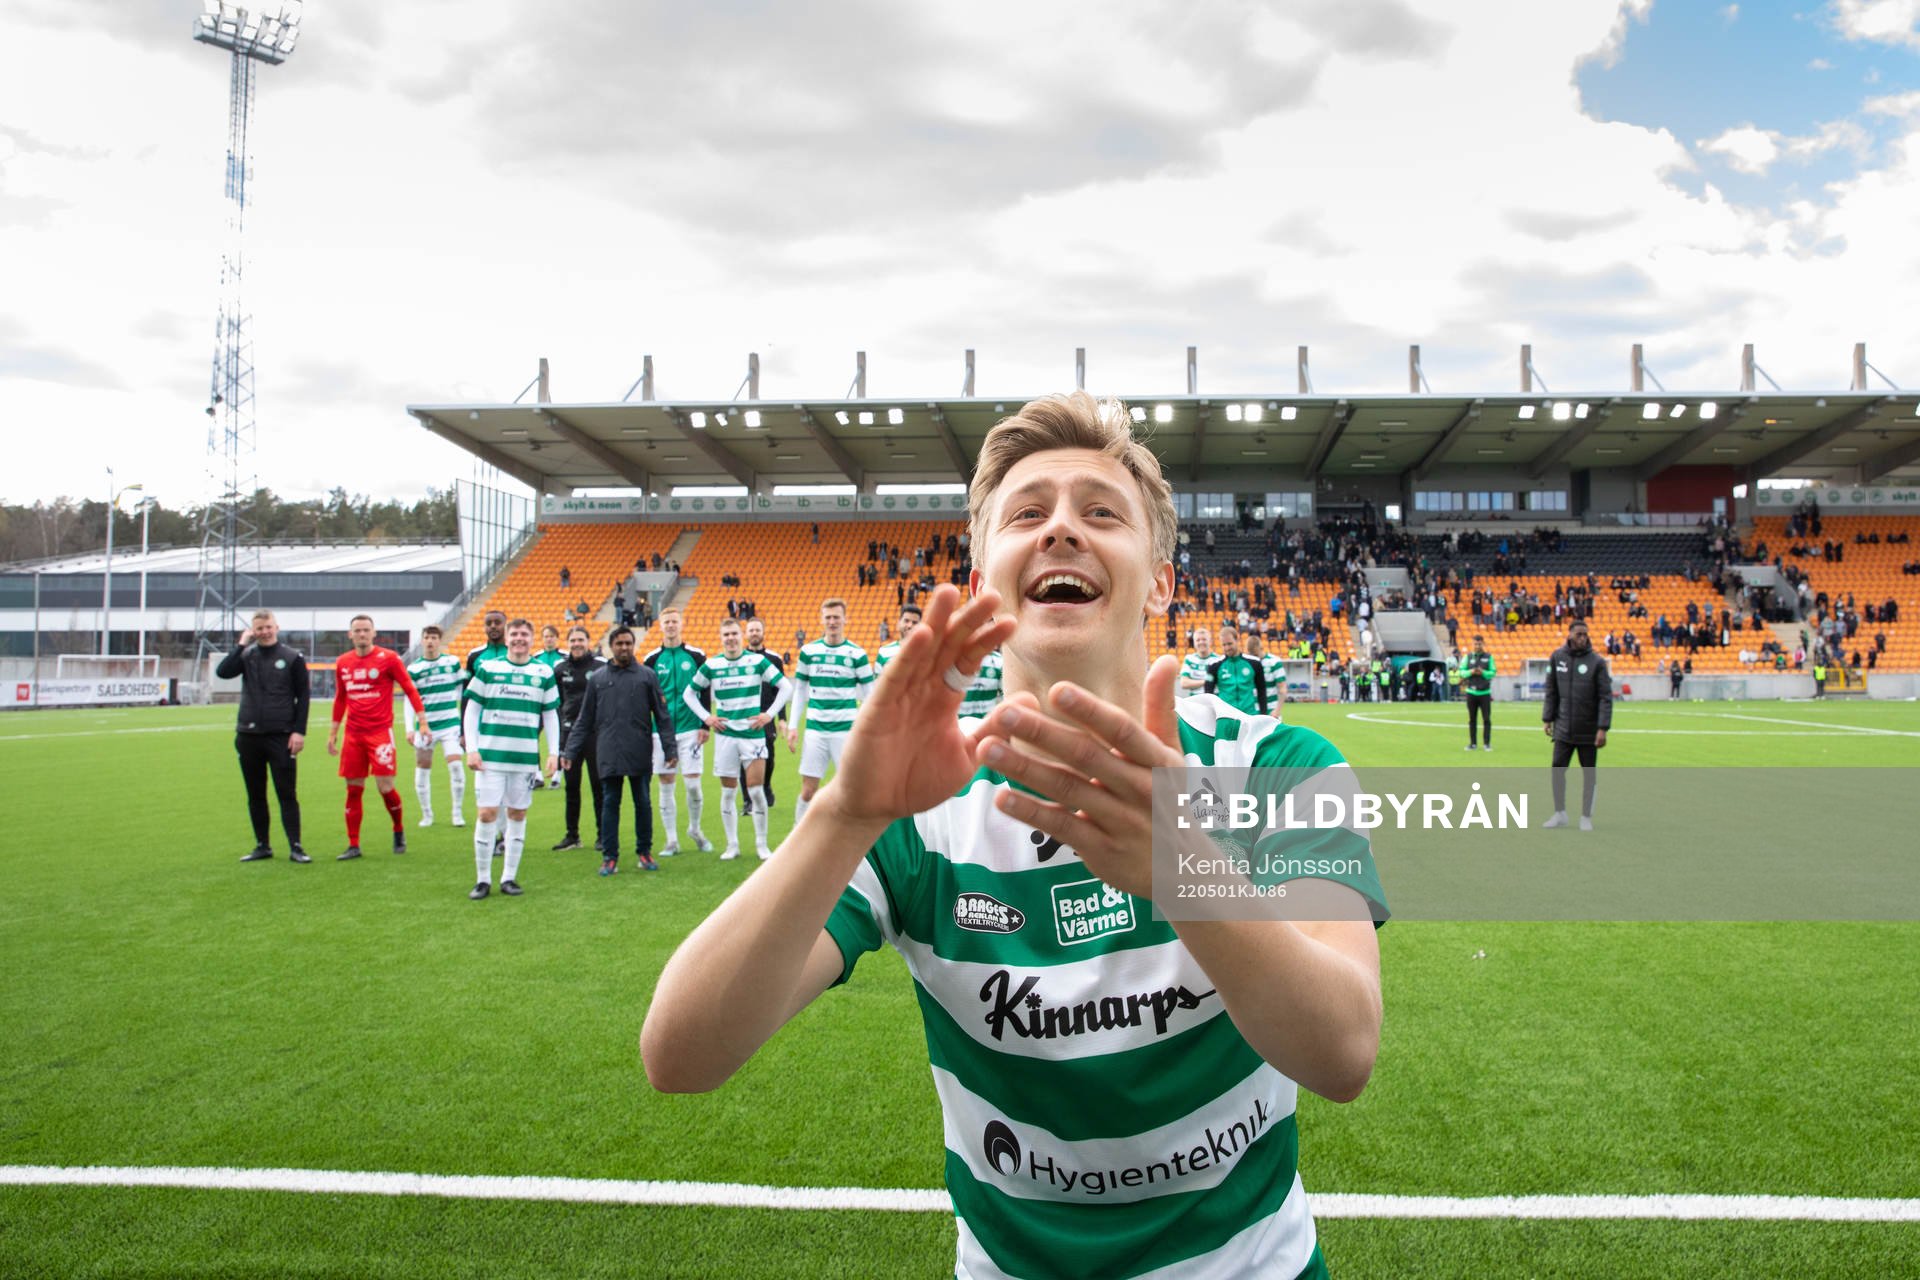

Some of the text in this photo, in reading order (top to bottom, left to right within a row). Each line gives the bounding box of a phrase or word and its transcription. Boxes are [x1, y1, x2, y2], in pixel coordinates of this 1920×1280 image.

[563, 500, 586, 511] skylt
[588, 501, 595, 510] &
[97, 683, 160, 697] SALBOHEDS
[1059, 882, 1126, 917] Bad &
[1061, 909, 1129, 938] Värme
[980, 969, 1217, 1042] Kinnarps
